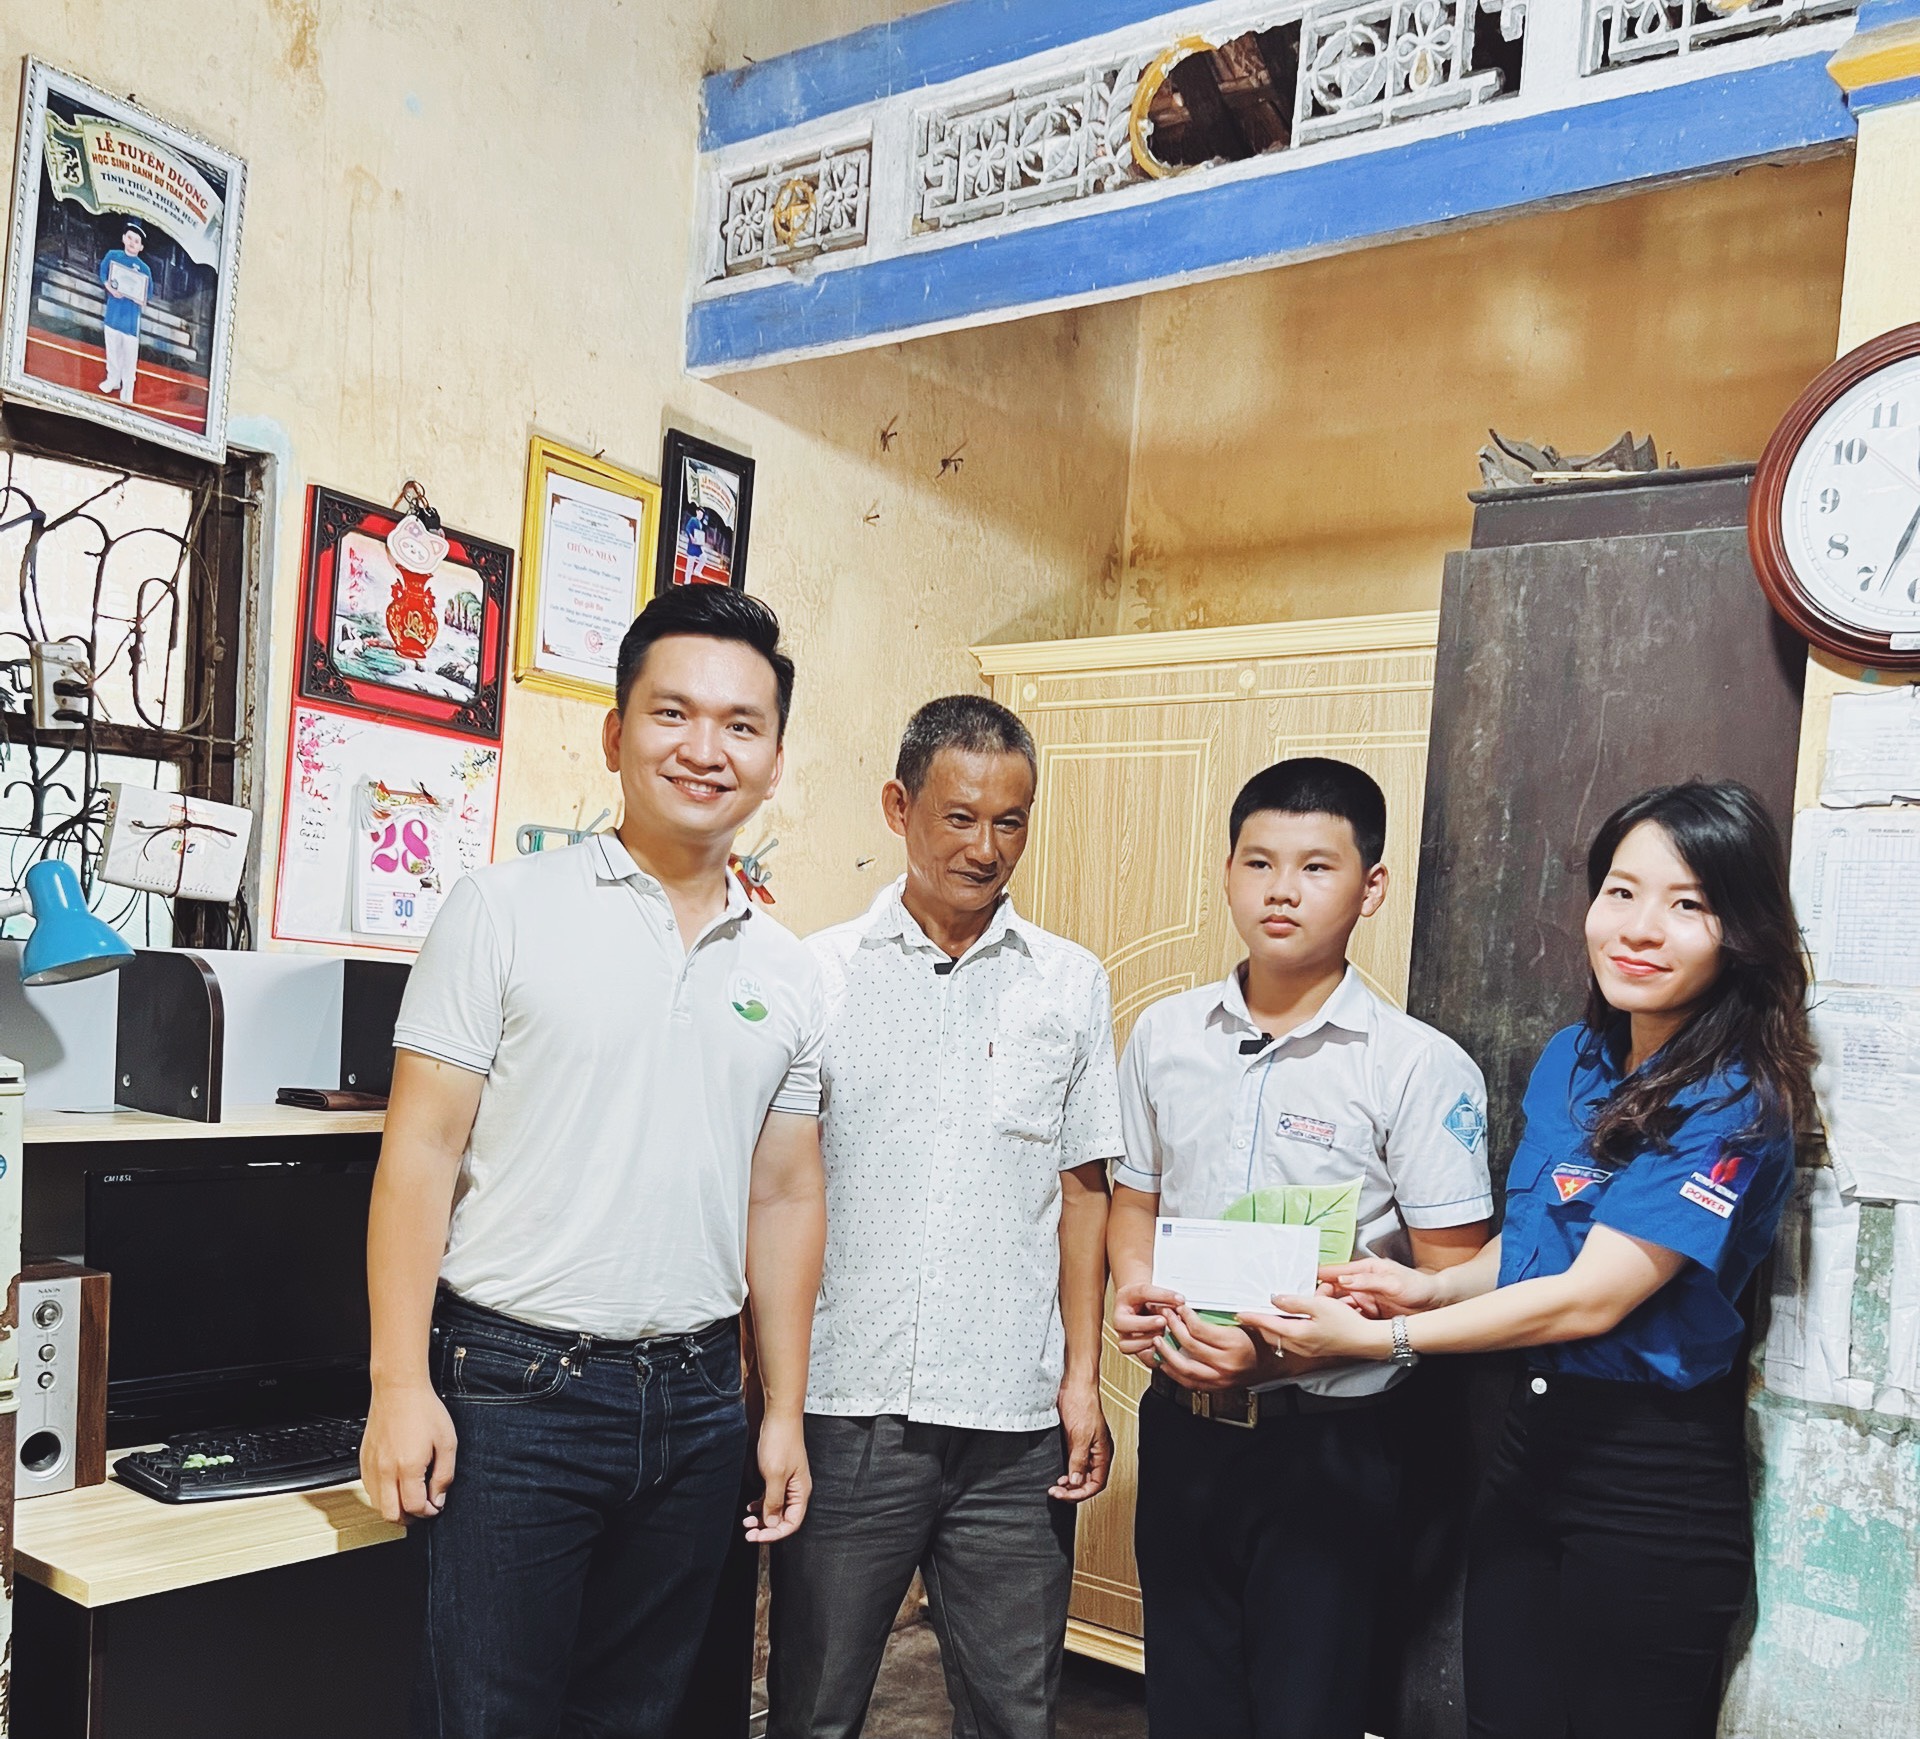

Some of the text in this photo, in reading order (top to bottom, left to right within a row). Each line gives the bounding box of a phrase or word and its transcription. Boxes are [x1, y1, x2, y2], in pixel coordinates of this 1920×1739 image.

[95, 131, 115, 153] LỄ
[118, 141, 165, 174] TUYÊN
[91, 153, 109, 166] HỌC
[111, 156, 130, 171] SINH
[132, 163, 153, 181] DANH
[1869, 401, 1901, 429] 11
[1832, 437, 1868, 466] 10
[1818, 487, 1841, 515] 9
[1826, 532, 1849, 560] 8
[1856, 565, 1878, 592] 7
[370, 819, 431, 876] 28
[395, 899, 414, 918] 30
[1685, 1187, 1726, 1213] POWER
